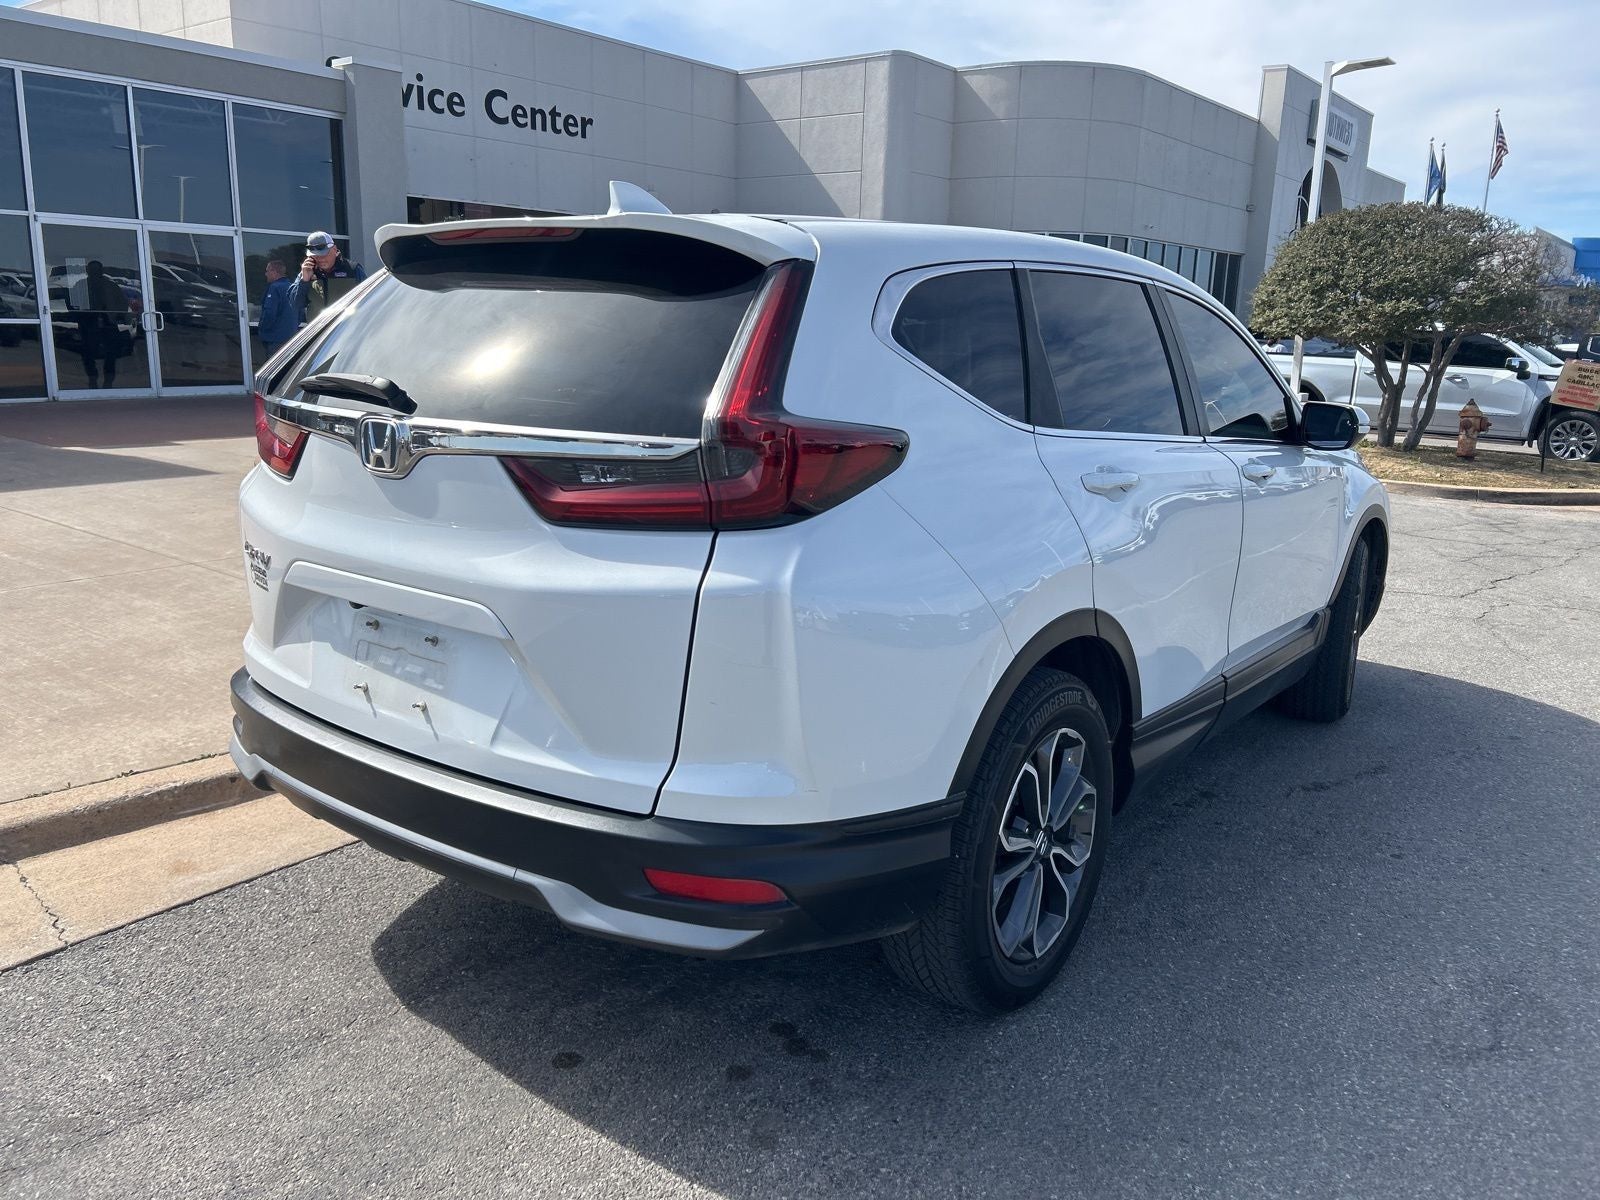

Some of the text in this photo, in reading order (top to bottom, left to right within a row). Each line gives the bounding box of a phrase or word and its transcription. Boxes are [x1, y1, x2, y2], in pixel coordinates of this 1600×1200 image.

[401, 73, 593, 139] vice Center
[1026, 691, 1082, 735] BRIDGESTONE
